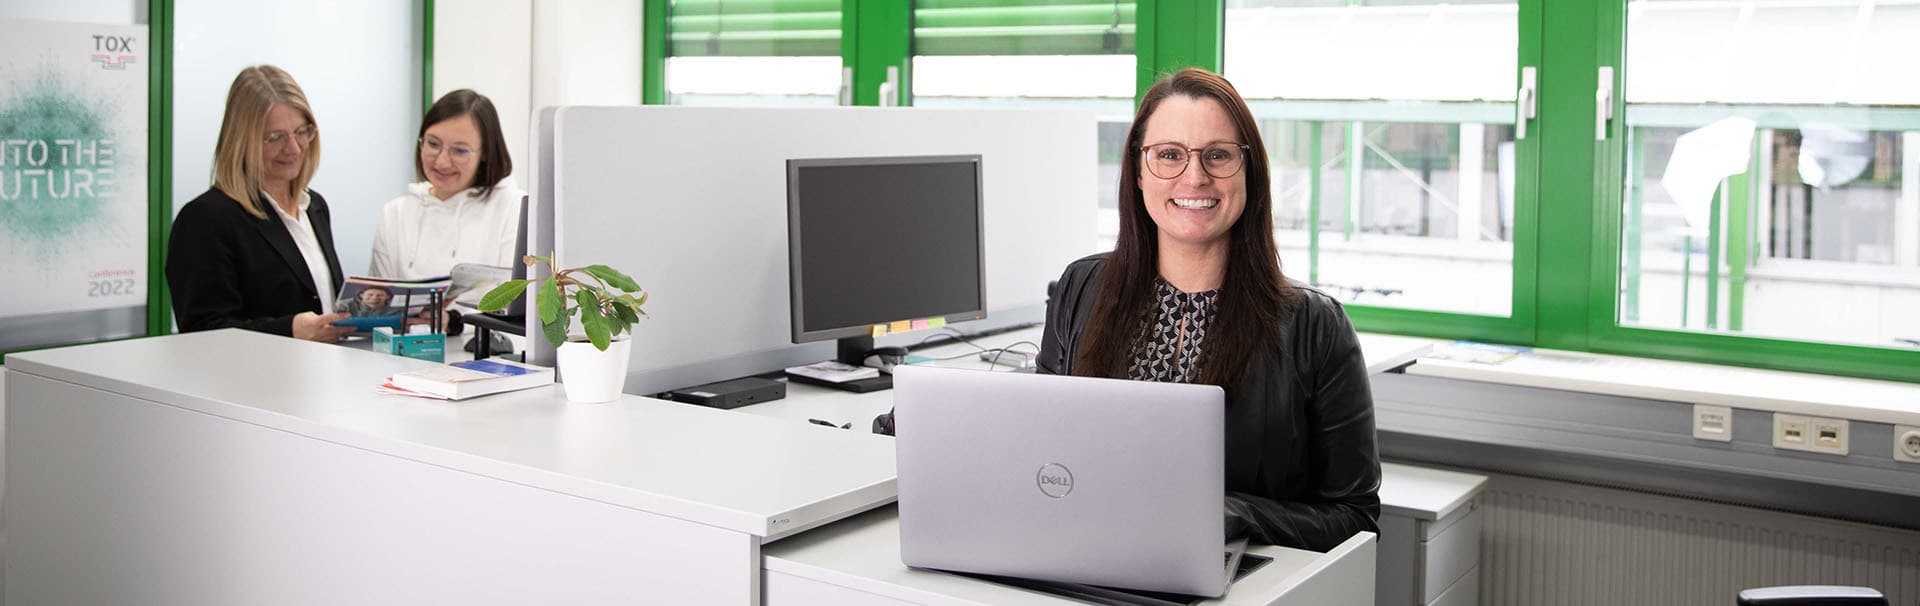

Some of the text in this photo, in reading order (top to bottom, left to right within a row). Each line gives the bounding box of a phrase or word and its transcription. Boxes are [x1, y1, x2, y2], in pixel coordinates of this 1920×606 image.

[0, 139, 113, 166] TO THE
[88, 279, 136, 297] 2022
[1041, 475, 1070, 486] DELL
